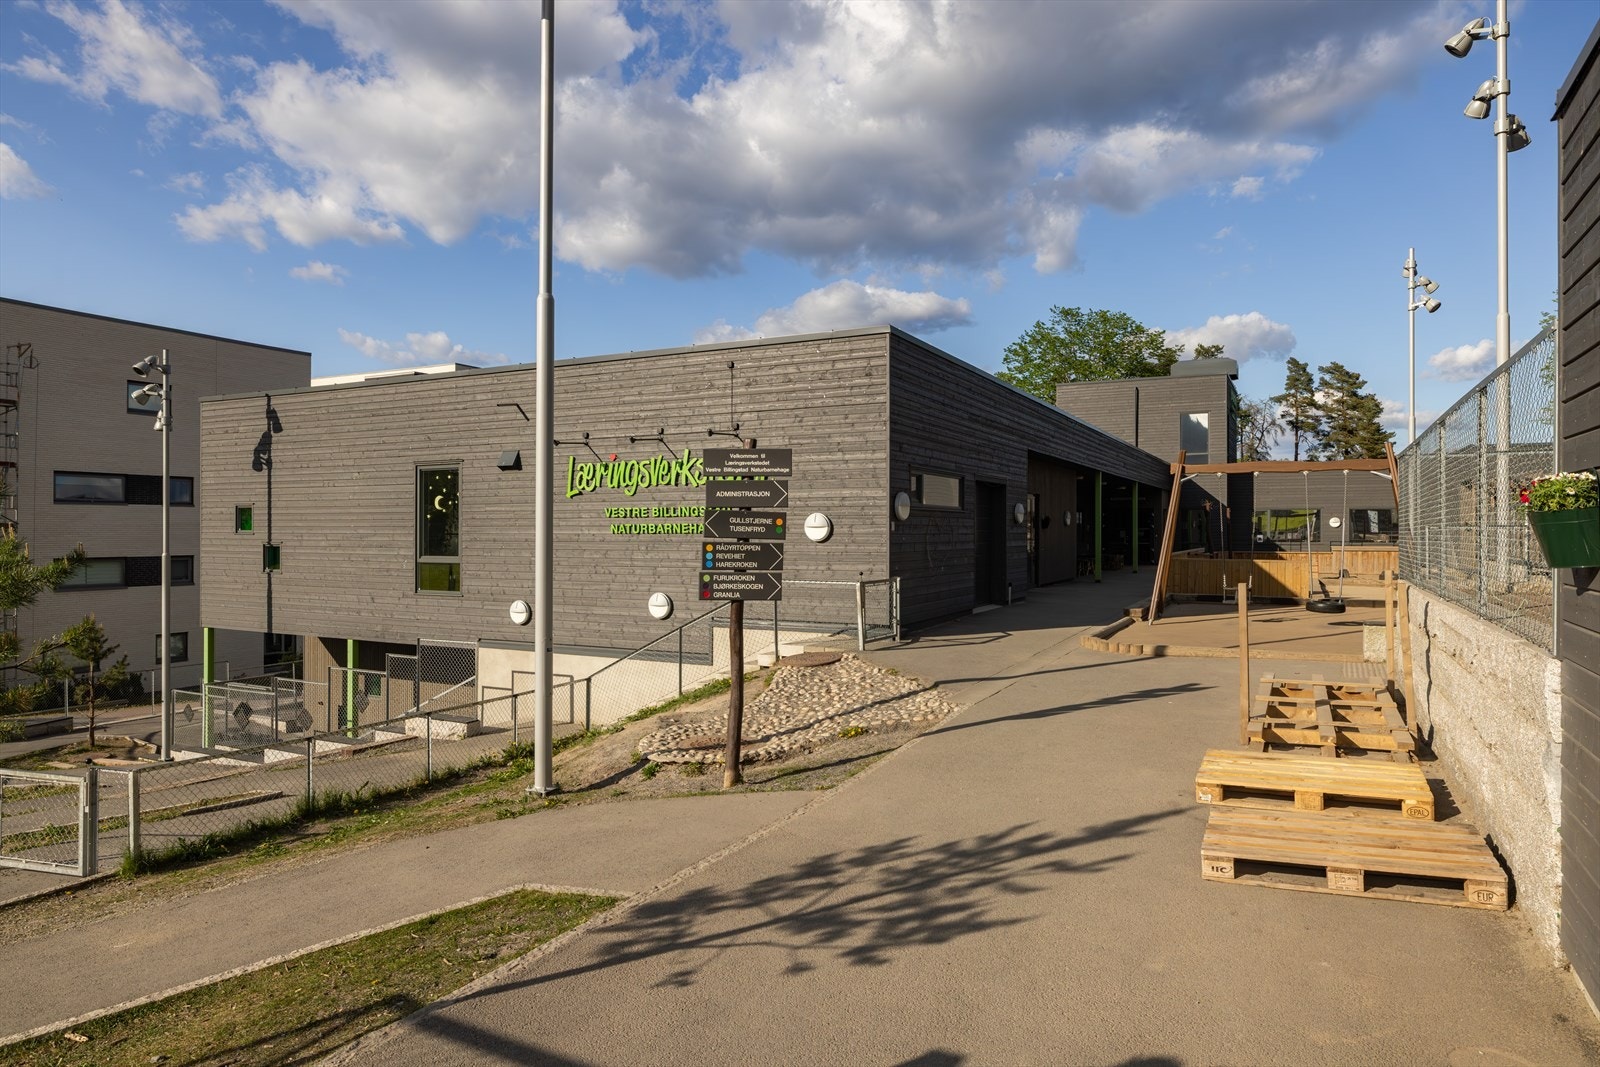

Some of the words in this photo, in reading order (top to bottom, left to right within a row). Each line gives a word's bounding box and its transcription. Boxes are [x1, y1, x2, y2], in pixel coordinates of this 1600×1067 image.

[566, 449, 768, 498] Læringsverks
[604, 507, 650, 518] VESTRE
[652, 506, 732, 518] BILLINGS
[729, 517, 773, 525] GULLSTJERNE
[610, 523, 705, 534] NATURBARNEHA
[716, 543, 761, 551] RÅDYRTOPPEN
[1409, 808, 1426, 817] EPAL
[1476, 892, 1494, 902] EUR
